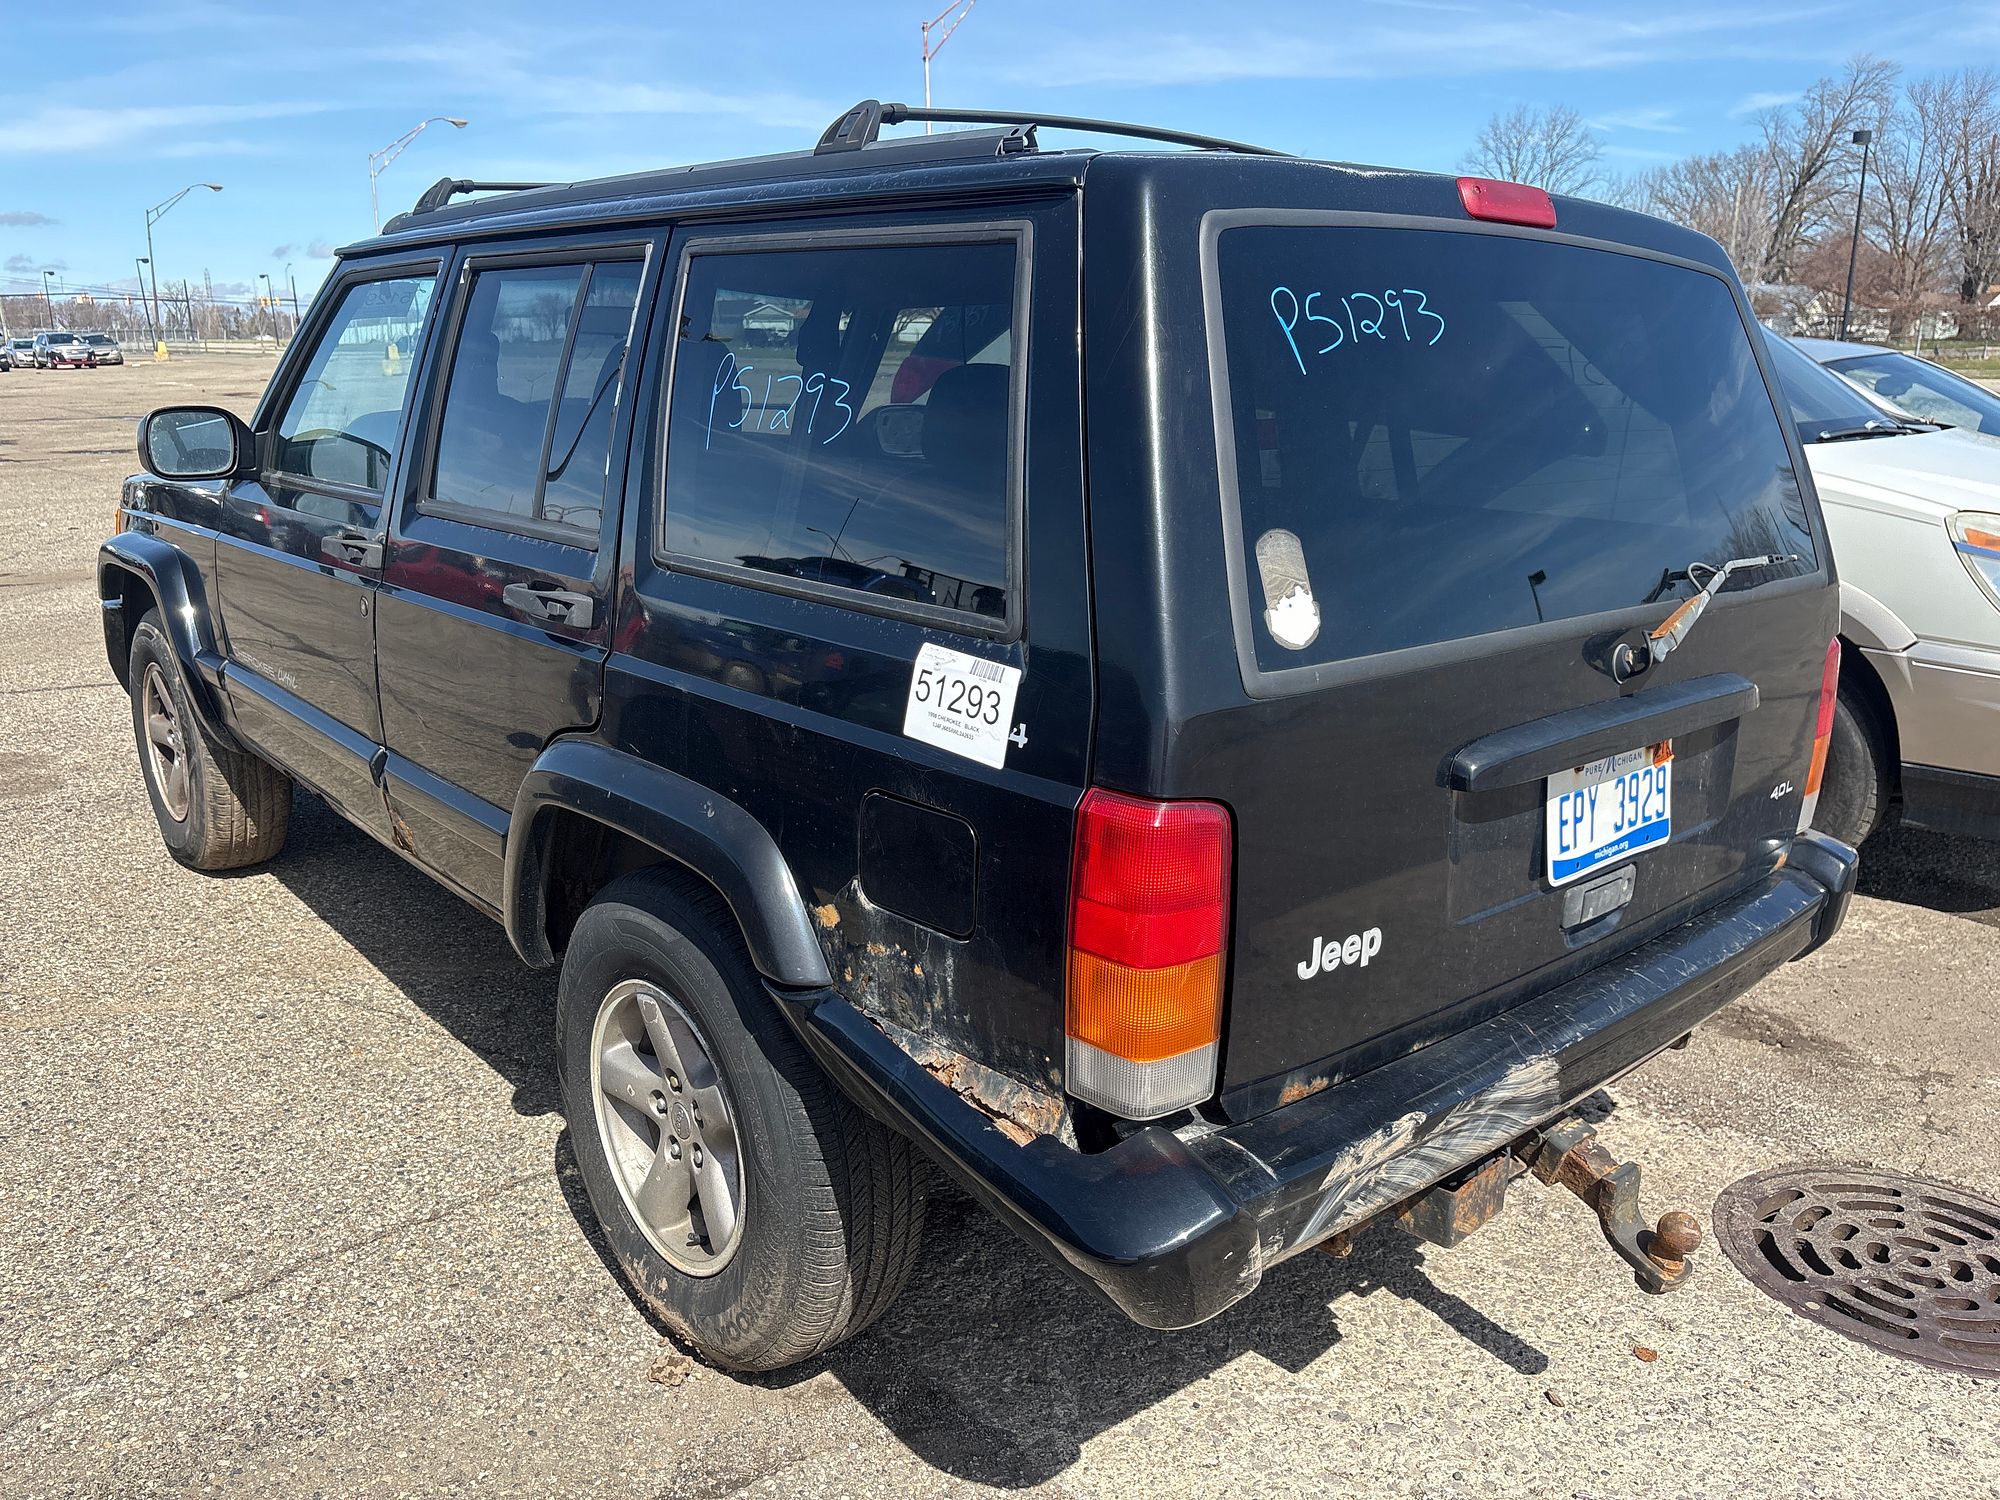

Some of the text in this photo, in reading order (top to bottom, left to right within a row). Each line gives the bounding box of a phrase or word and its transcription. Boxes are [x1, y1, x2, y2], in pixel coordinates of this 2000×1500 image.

[1271, 286, 1445, 375] P51293
[706, 352, 852, 450] P51293
[915, 669, 1001, 725] 51293
[1585, 766, 1602, 776] PURE
[1559, 765, 1667, 854] EPY 3929
[1594, 841, 1629, 860] michigan.org
[1297, 927, 1382, 980] Jeep
